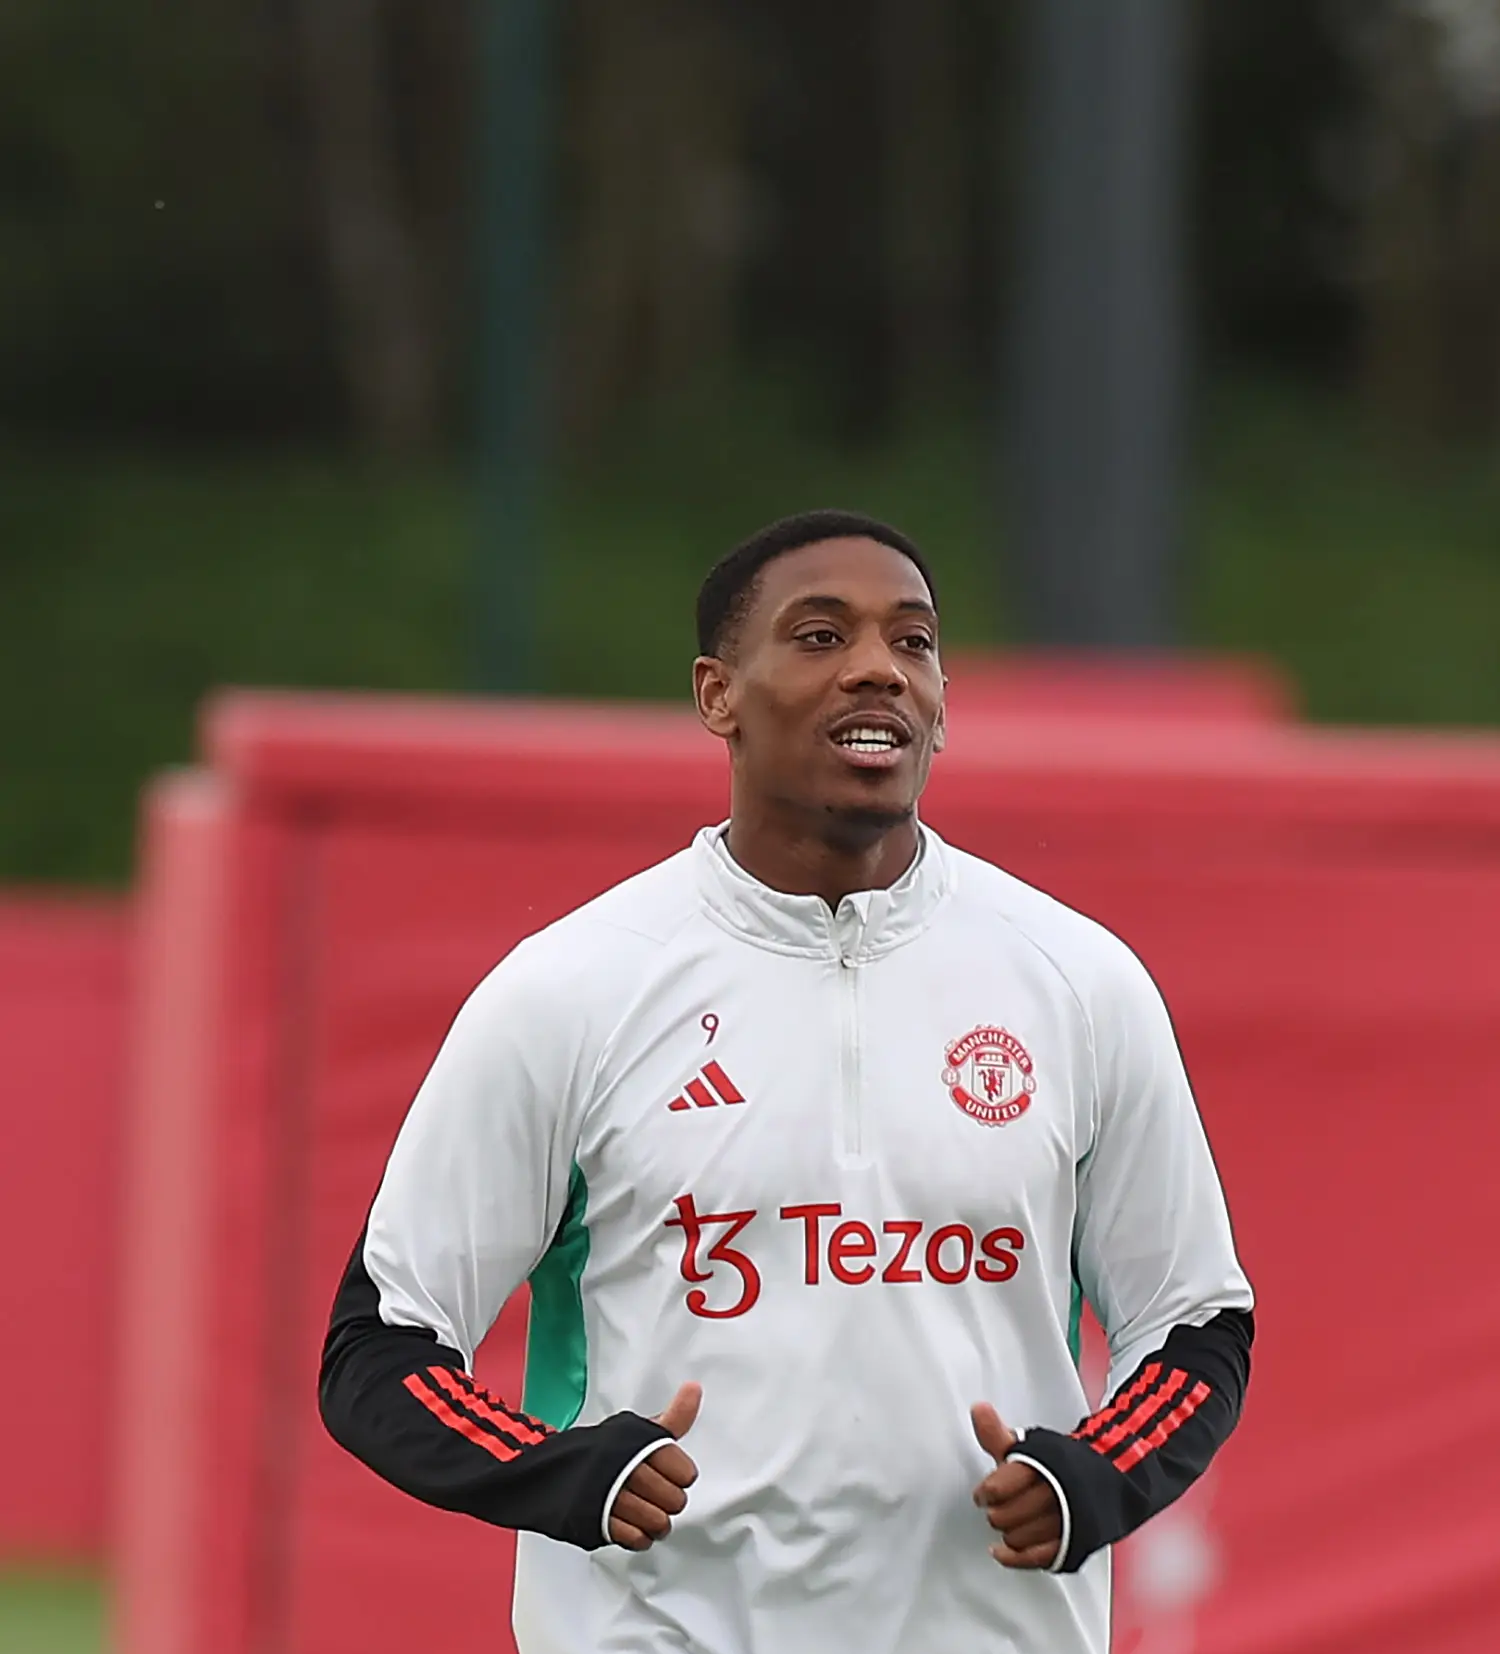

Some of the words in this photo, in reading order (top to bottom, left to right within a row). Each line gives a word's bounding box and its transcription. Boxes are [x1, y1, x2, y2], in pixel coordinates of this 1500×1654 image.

[701, 1013, 719, 1045] 9
[953, 1032, 1029, 1068] MANCHESTER
[965, 1100, 1020, 1119] UNITED
[780, 1202, 1025, 1285] Tezos
